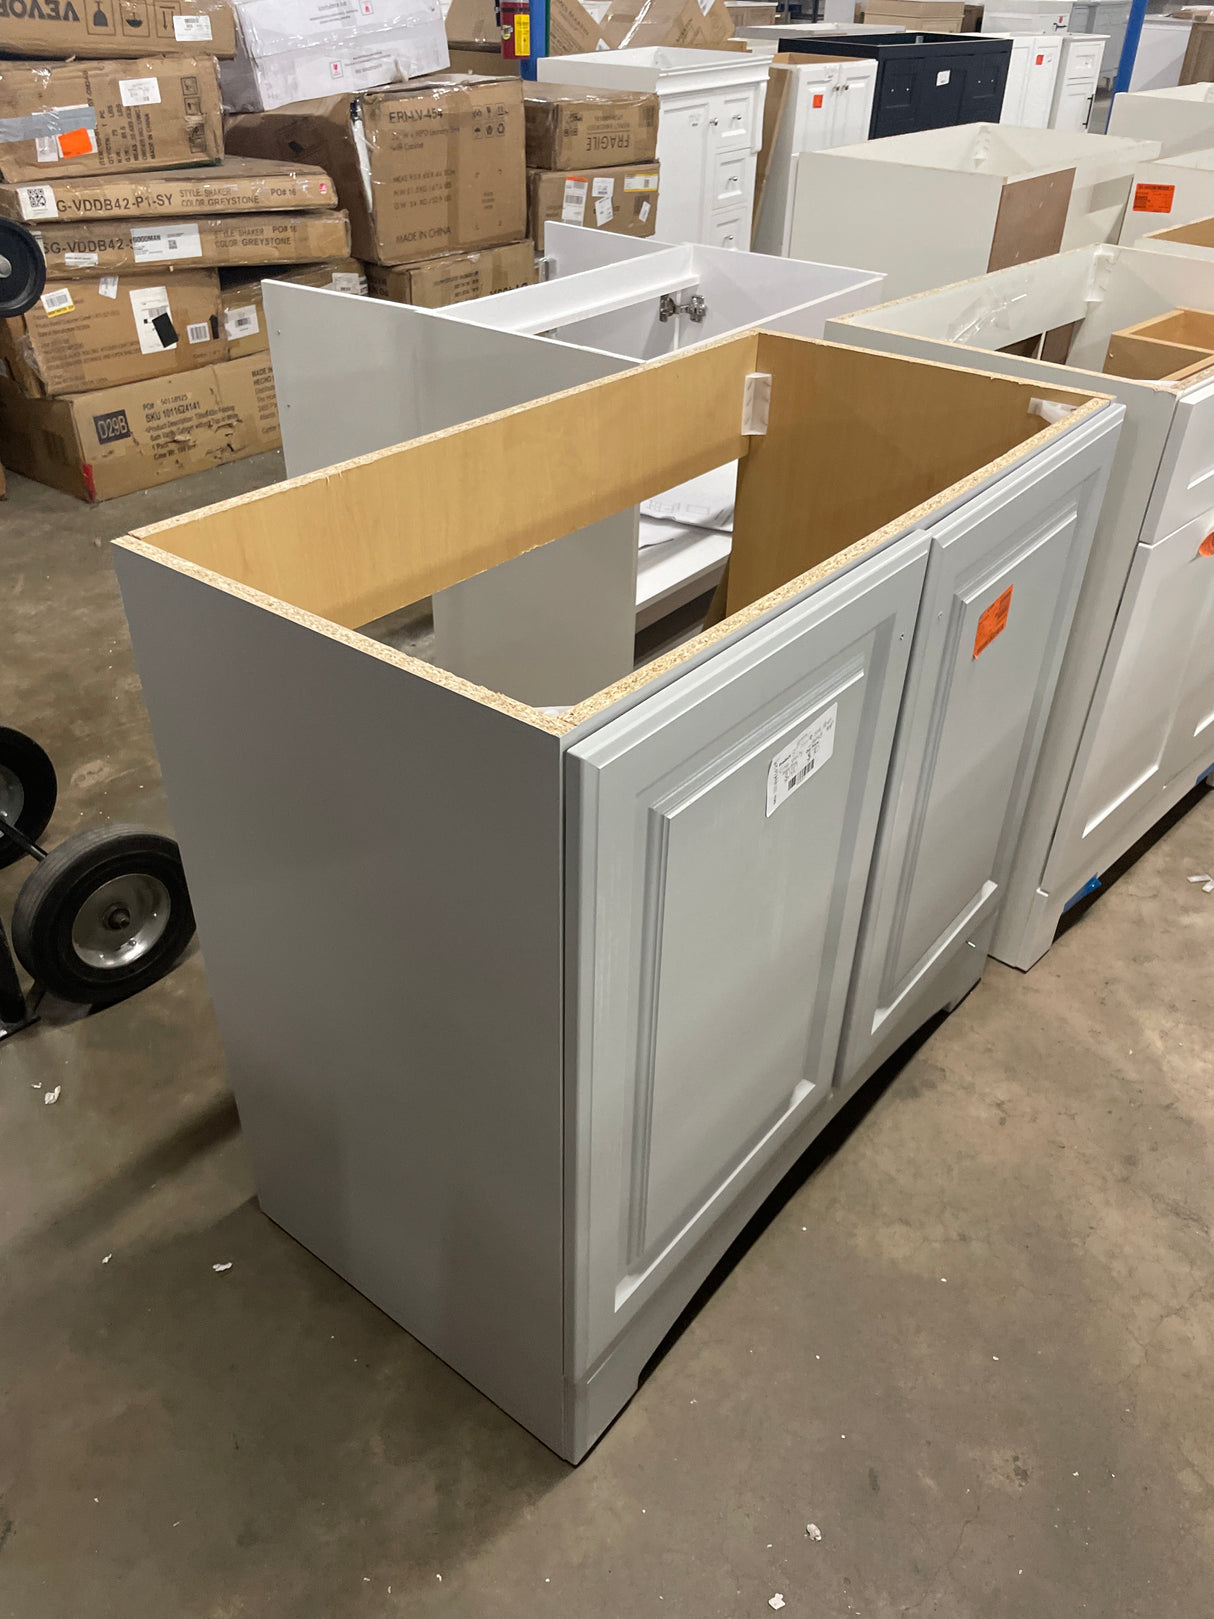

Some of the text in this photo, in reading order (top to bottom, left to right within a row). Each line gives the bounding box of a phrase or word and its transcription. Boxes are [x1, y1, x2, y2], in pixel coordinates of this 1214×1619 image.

[586, 134, 631, 152] FRAGILE
[44, 238, 133, 254] SG-VDDB42-
[241, 237, 292, 246] GREYSTONE
[145, 410, 161, 423] SKU
[98, 415, 128, 438] D29B
